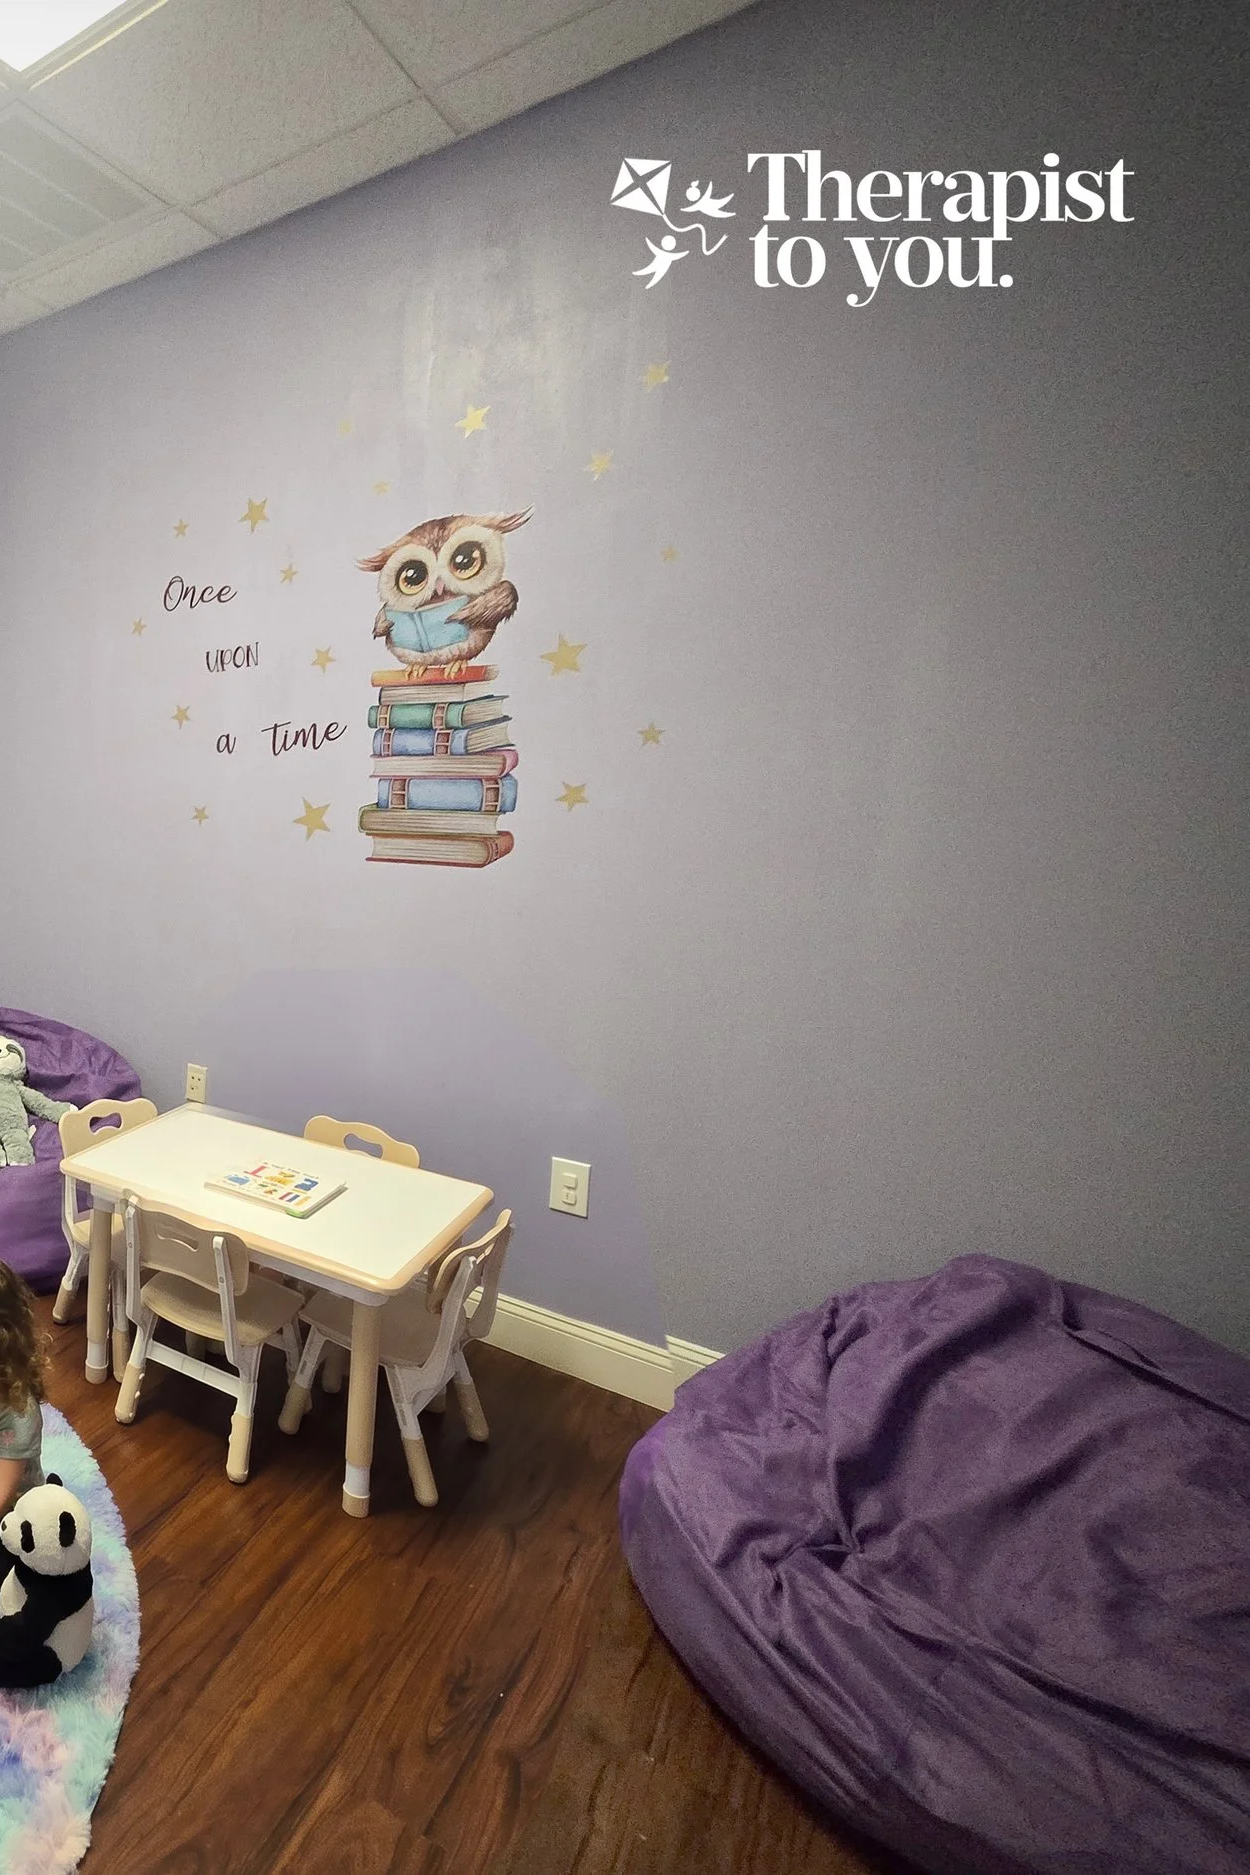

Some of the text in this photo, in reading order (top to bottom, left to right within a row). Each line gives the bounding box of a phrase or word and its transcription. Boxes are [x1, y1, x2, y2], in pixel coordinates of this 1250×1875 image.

[163, 576, 238, 612] Once
[205, 642, 259, 673] UPON
[216, 733, 237, 755] a
